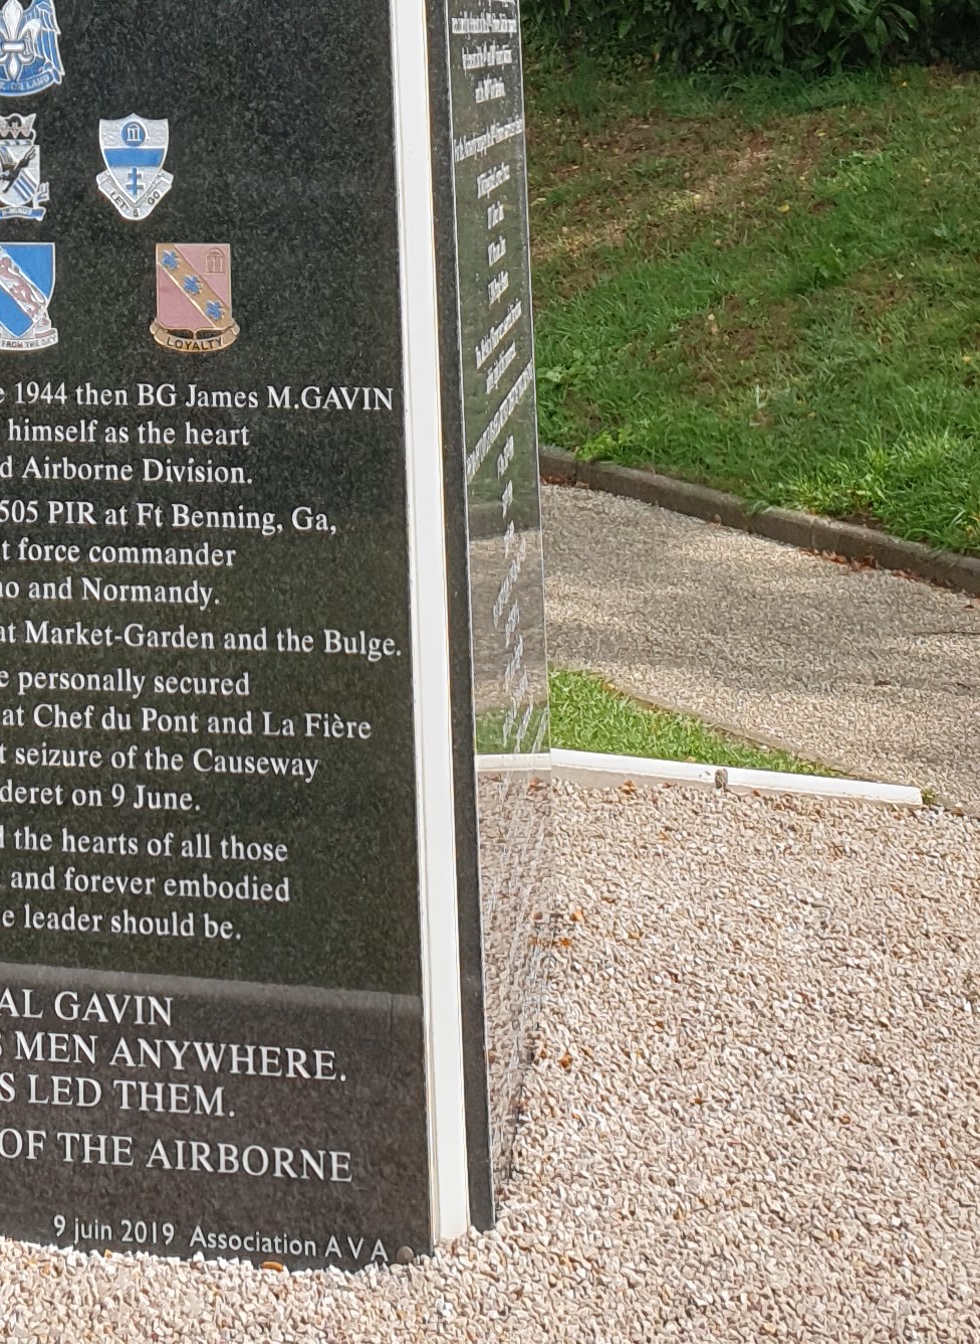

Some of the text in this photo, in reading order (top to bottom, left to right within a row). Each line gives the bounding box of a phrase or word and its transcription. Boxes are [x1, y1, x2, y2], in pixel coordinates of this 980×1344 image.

[147, 190, 161, 205] GO
[1, 340, 24, 348] FROM
[25, 340, 40, 348] THE
[166, 336, 223, 351] LOYALTY
[14, 380, 68, 406] 1944
[75, 381, 129, 406] then
[136, 383, 178, 407] BG
[185, 383, 259, 409] James
[266, 385, 394, 411] M.GAVIN
[7, 417, 99, 443] himself
[104, 426, 130, 444] as
[137, 420, 176, 445] the
[184, 421, 250, 447] heart
[21, 455, 134, 482] Airborne
[142, 457, 253, 485] Division.
[47, 500, 98, 525] PIR
[104, 504, 129, 527] at
[135, 502, 164, 528] Ft
[171, 503, 283, 537] Benning,
[291, 506, 337, 536] Ga,
[17, 536, 81, 564] force
[88, 541, 237, 568] commander
[28, 575, 73, 601] and
[81, 576, 220, 612] Normandy.
[24, 619, 216, 650] Market-Garden
[223, 626, 268, 652] and
[276, 627, 314, 653] the
[323, 628, 402, 663] Bulge.
[17, 667, 146, 700] personally
[153, 671, 250, 697] secured
[2, 704, 25, 728] at
[33, 703, 95, 730] Chef
[101, 705, 132, 732] du
[141, 707, 199, 734] Pont
[207, 710, 254, 736] and
[262, 711, 296, 737] La
[304, 712, 372, 740] Fière
[14, 741, 103, 769] seizure
[110, 744, 139, 770] of
[144, 745, 184, 772] the
[193, 747, 319, 784] Causeway
[71, 788, 103, 807] on
[111, 783, 126, 808] 9
[132, 784, 201, 812] June.
[13, 825, 53, 852] the
[61, 827, 139, 856] hearts
[146, 831, 175, 857] of
[181, 832, 212, 859] all
[220, 834, 288, 862] those
[10, 865, 56, 891] and
[63, 866, 156, 896] forever
[163, 872, 291, 903] embodied
[23, 902, 103, 933] leader
[110, 908, 196, 937] should
[203, 912, 242, 940] be.
[54, 990, 174, 1027] GAVIN
[14, 1030, 99, 1065] MEN
[108, 1036, 347, 1082] ANYWHERE.
[27, 1073, 102, 1107] LED
[113, 1079, 235, 1118] THEM.
[56, 1131, 135, 1167] THE
[145, 1138, 353, 1183] AIRBORNE
[53, 1214, 390, 1262] 9 juin 2019 Association A V A
